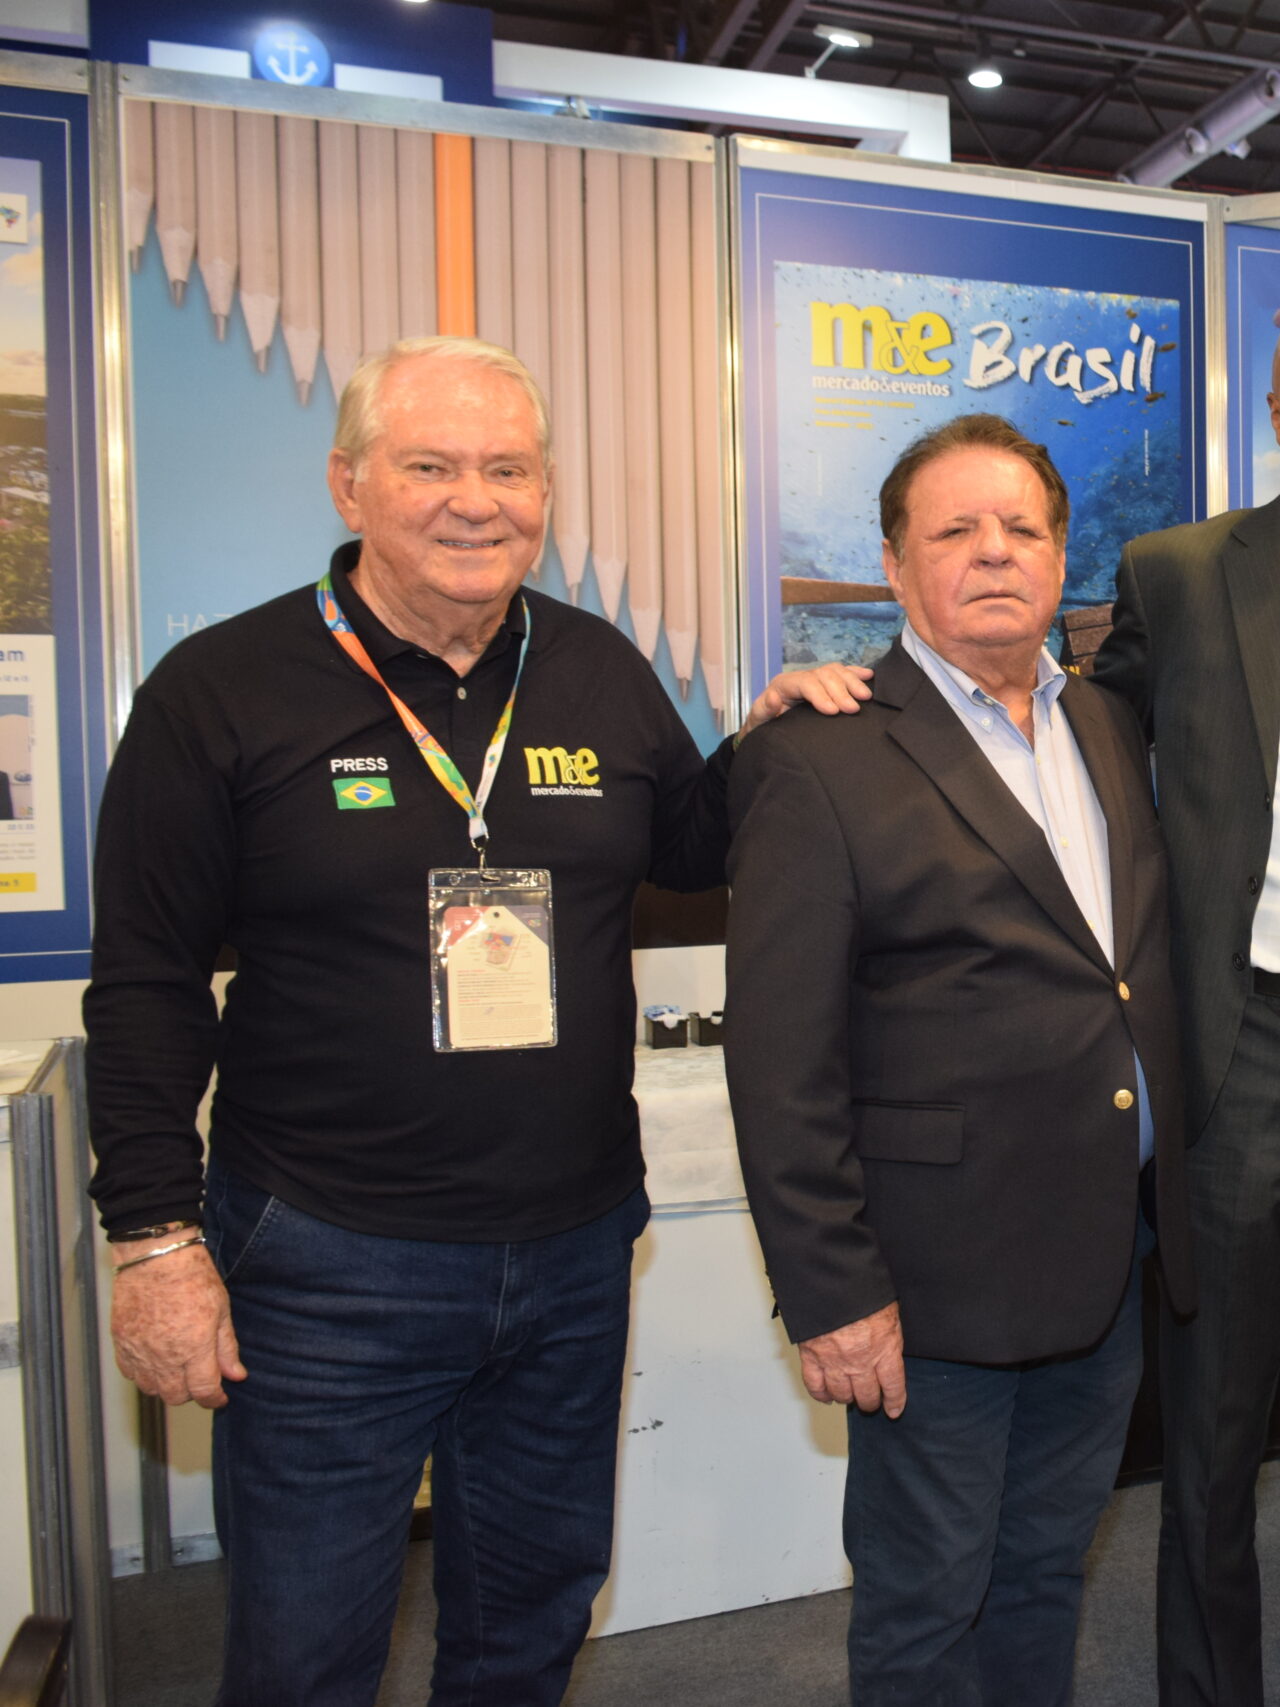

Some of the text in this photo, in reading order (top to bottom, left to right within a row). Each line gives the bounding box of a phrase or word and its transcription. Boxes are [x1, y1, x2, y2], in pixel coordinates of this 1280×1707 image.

[810, 301, 1158, 404] m&e Brasil
[811, 375, 950, 397] mercado&eventos
[329, 757, 389, 773] PRESS
[523, 746, 601, 786] m&e
